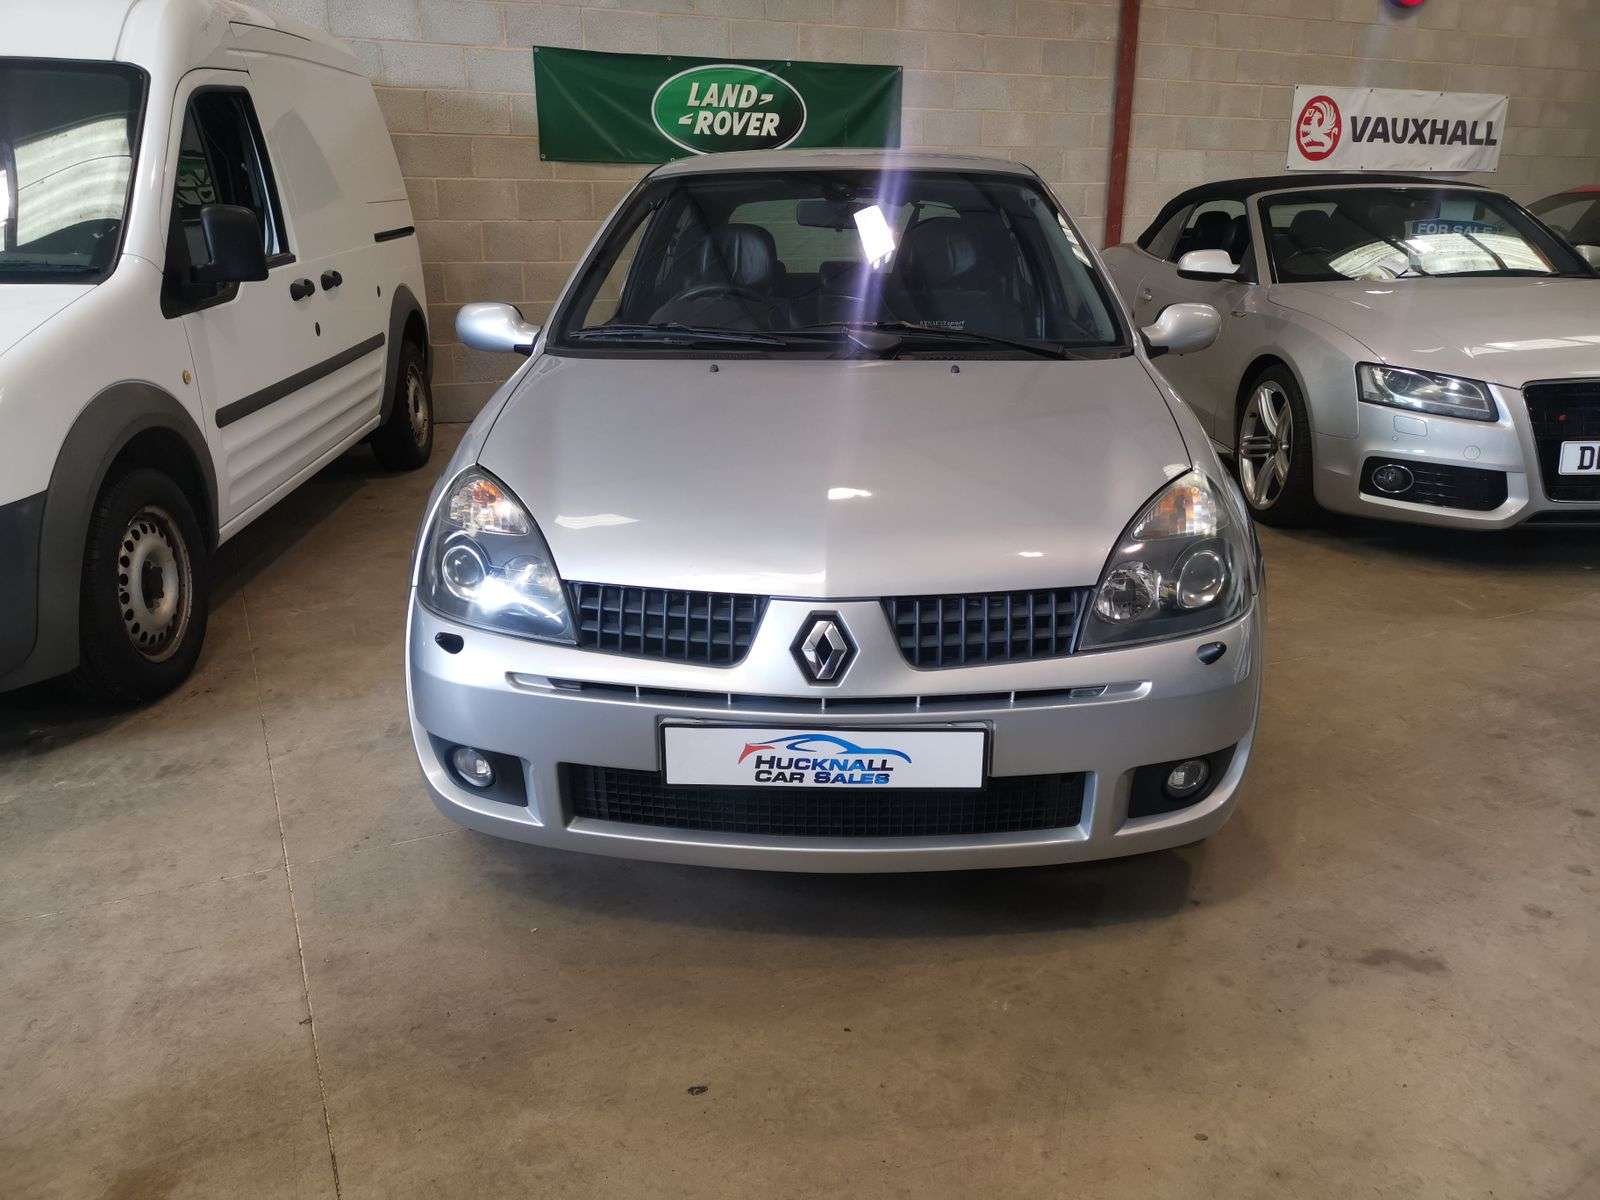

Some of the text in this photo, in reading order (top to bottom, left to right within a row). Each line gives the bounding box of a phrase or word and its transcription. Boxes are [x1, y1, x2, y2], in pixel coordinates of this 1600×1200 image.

[687, 82, 758, 108] LAND
[693, 111, 780, 136] ROVER
[1351, 116, 1497, 146] VAUXHALL
[1416, 223, 1449, 235] FOR
[1577, 446, 1600, 470] D
[755, 755, 894, 771] HUCKNALL
[754, 770, 890, 784] CAR SALES
